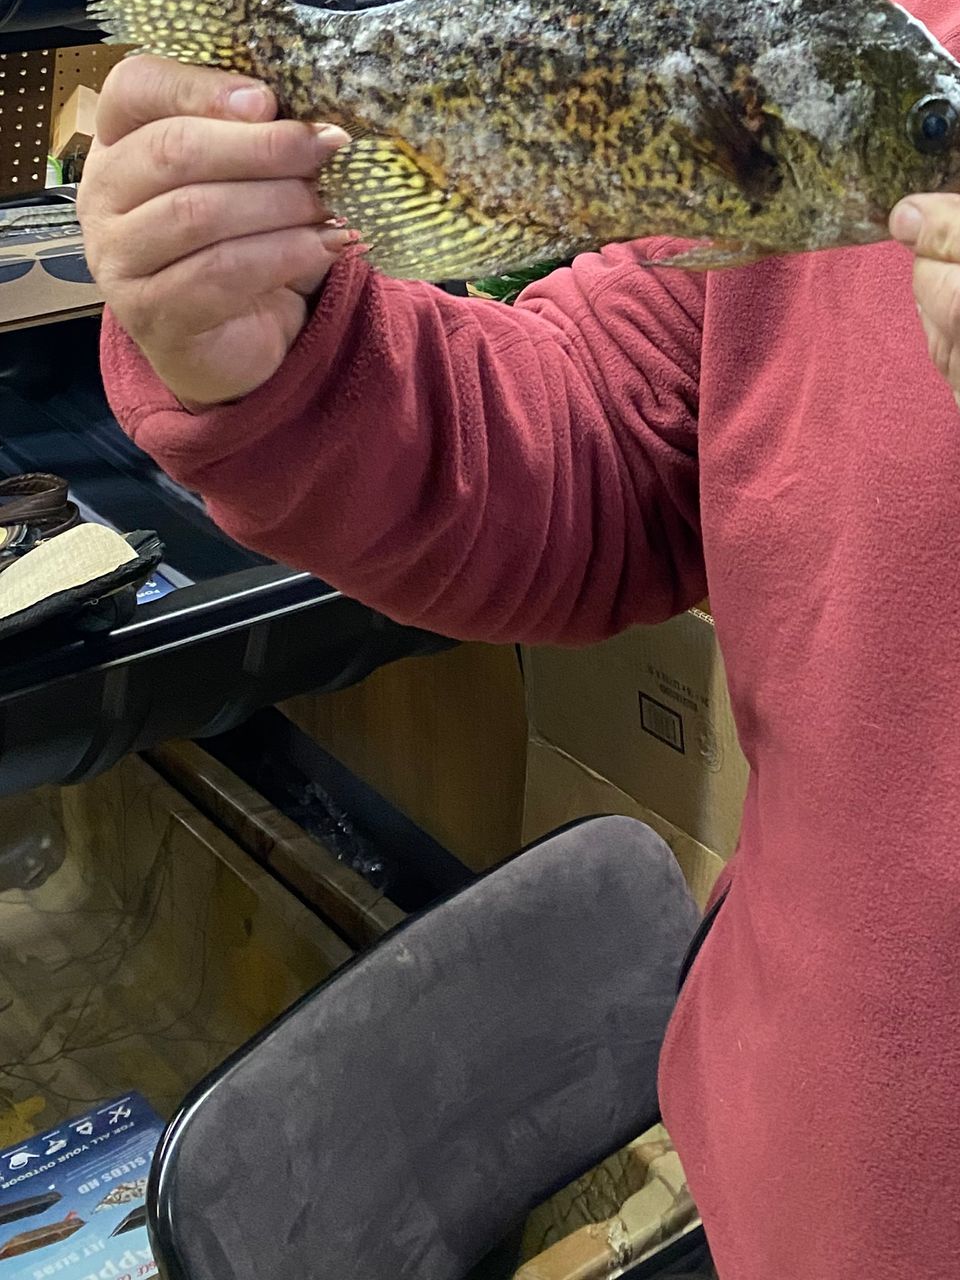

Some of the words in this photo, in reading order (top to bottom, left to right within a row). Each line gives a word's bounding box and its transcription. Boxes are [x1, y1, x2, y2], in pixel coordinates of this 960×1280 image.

[114, 1121, 135, 1135] FOR
[90, 1132, 111, 1145] ALL
[58, 1144, 89, 1163] YOUR
[1, 1161, 56, 1189] OUTDOOR
[101, 1156, 146, 1183] SLEDS
